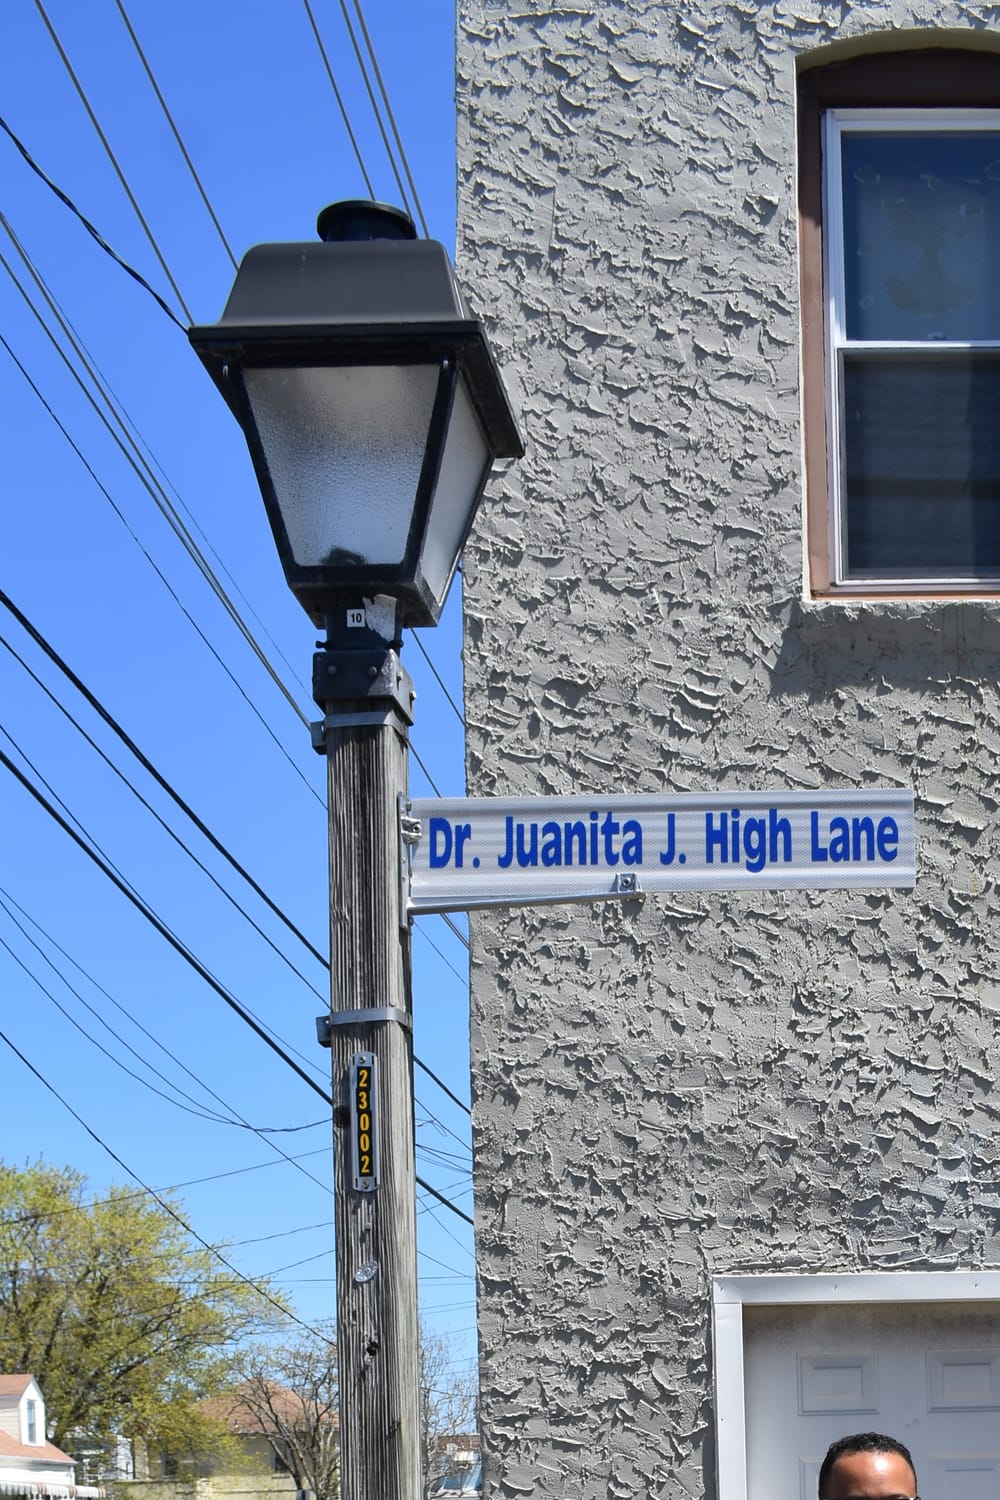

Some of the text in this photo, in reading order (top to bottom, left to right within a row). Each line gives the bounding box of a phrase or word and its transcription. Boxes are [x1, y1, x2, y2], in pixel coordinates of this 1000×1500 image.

[351, 613, 362, 623] 10
[429, 808, 898, 872] Dr. Juanita J. High Lane
[358, 1069, 370, 1173] 23002
